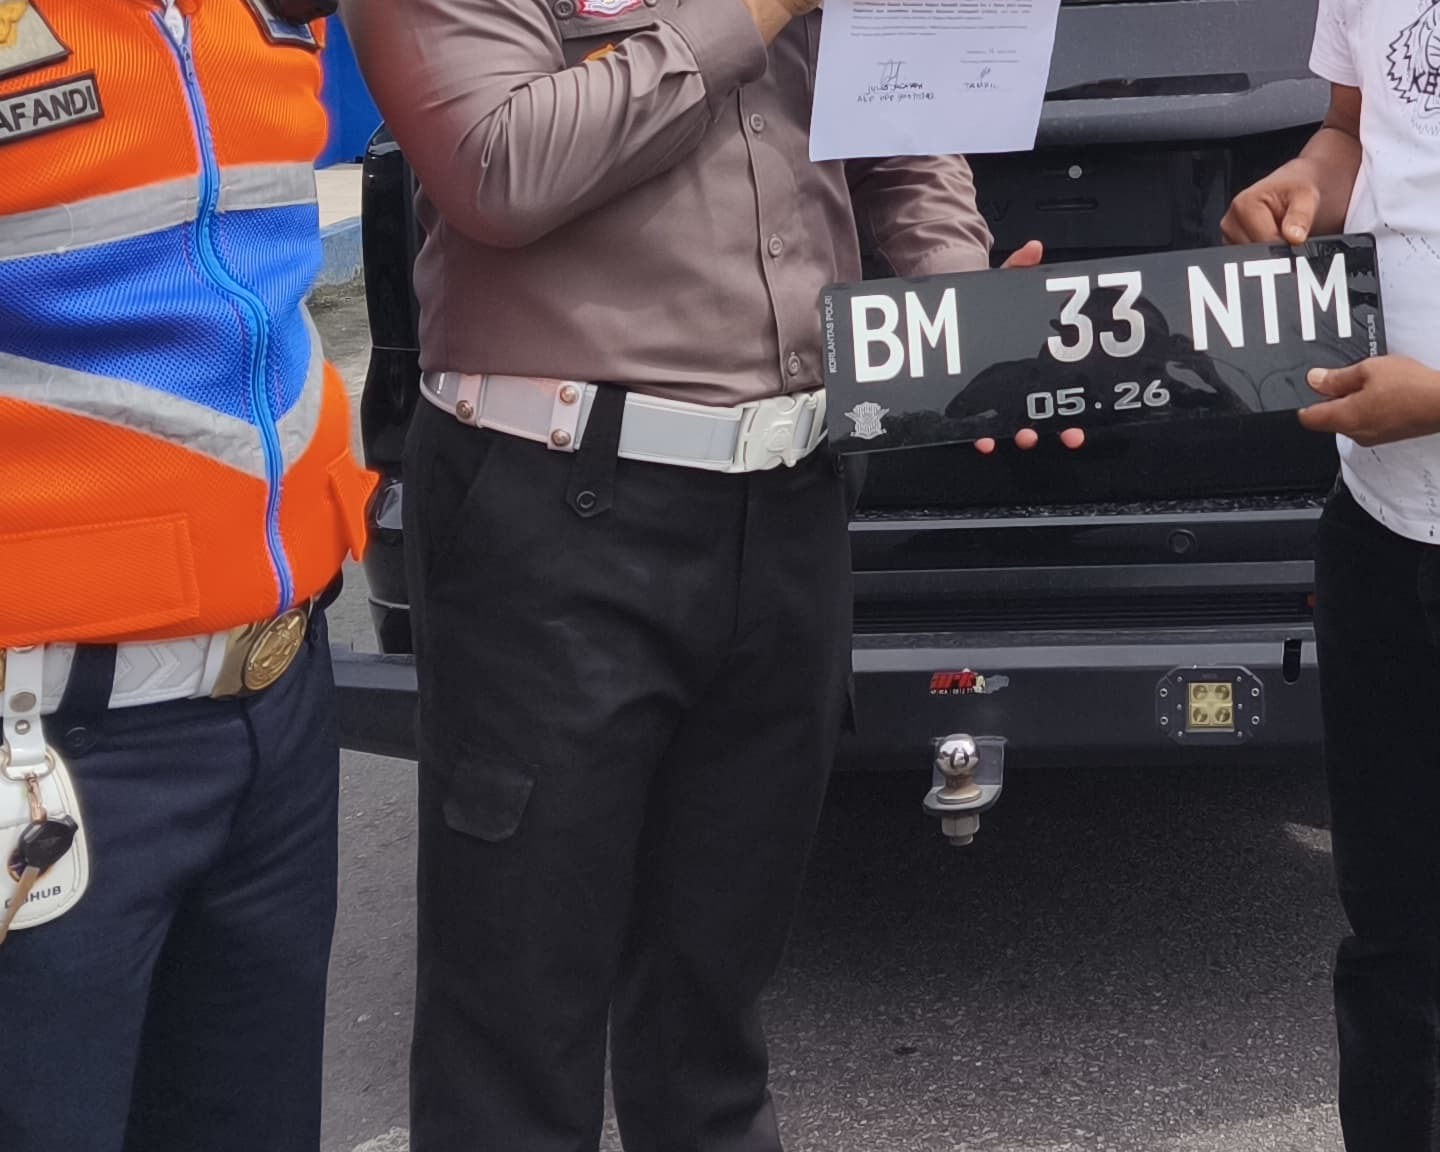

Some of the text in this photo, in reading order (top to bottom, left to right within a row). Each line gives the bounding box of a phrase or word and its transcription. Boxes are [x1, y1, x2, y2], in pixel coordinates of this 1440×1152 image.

[825, 295, 837, 374] KORLANTAS POLRI
[850, 252, 1352, 383] BM 33 NTM
